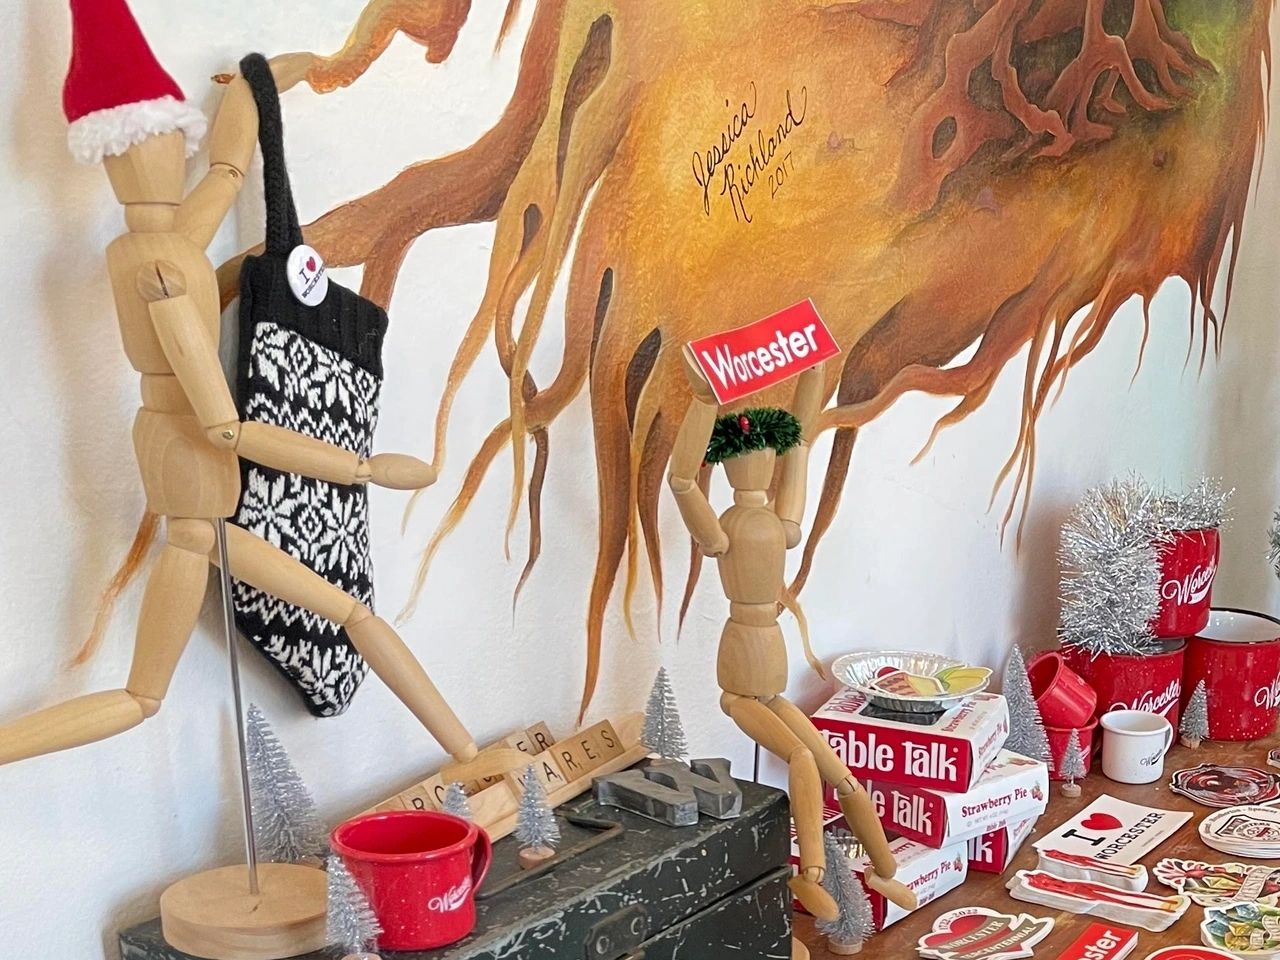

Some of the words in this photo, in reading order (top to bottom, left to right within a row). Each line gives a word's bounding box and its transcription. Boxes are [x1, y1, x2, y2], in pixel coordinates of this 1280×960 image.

[692, 81, 757, 216] Jessica
[720, 86, 808, 224] Richland
[768, 151, 795, 199] 2017
[702, 323, 818, 390] Worcester
[902, 741, 958, 782] Talk
[891, 790, 932, 837] Talk
[961, 793, 1012, 818] Strawberry
[1013, 787, 1028, 801] Pie
[1061, 829, 1106, 846] I
[1094, 812, 1164, 861] WORCESTER
[904, 866, 940, 892] rawberry
[940, 860, 952, 873] Pie
[940, 921, 1005, 951] WORCESTER
[959, 925, 1037, 960] TERCENTENNIAL
